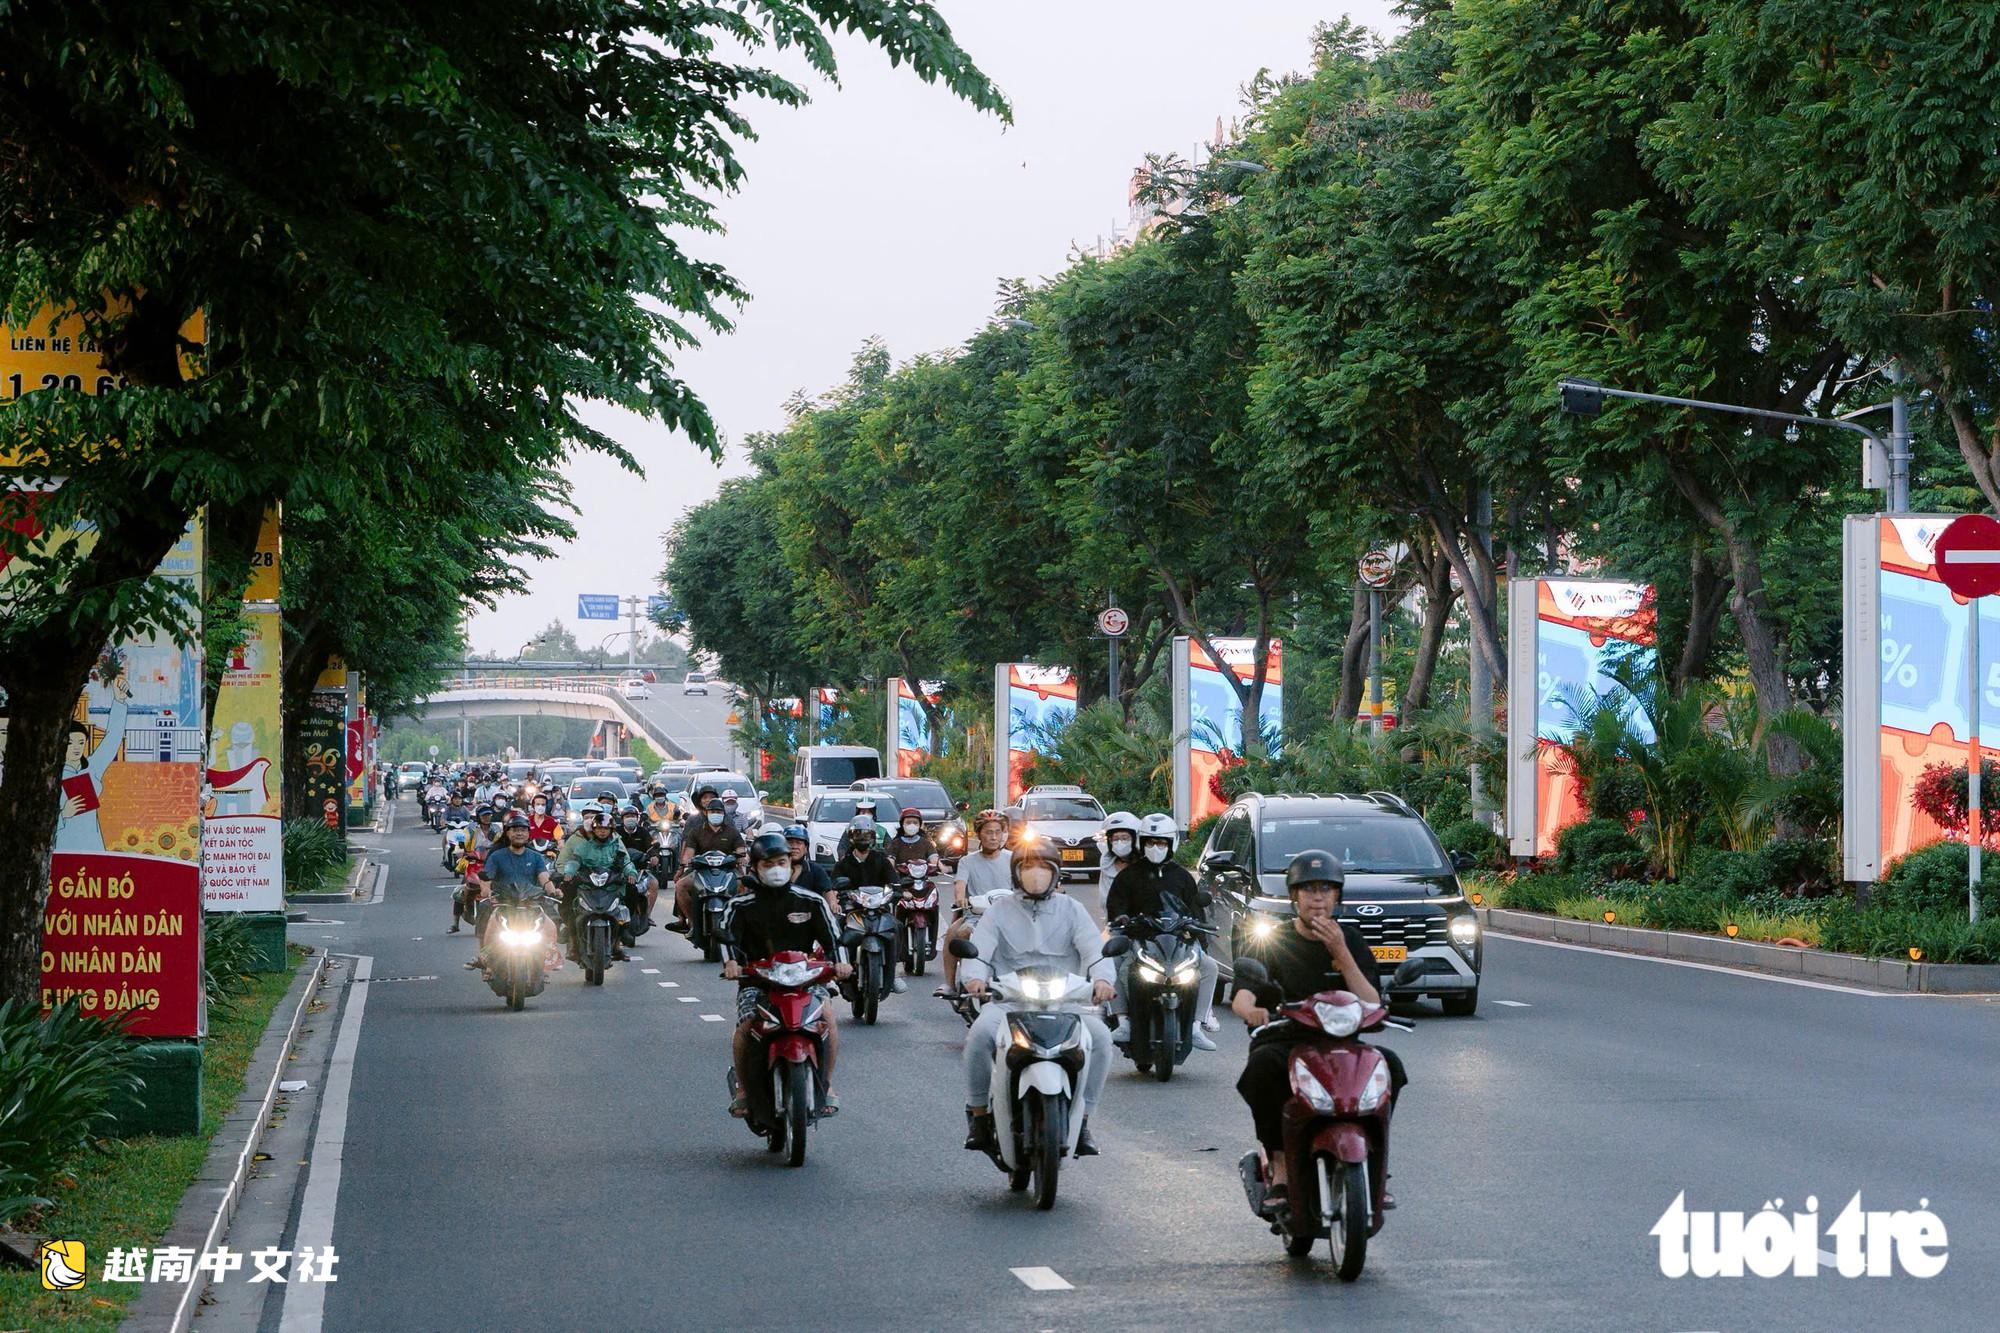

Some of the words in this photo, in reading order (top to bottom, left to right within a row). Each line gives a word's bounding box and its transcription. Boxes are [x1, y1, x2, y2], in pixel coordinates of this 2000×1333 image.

[11, 336, 45, 351] LIÊN
[52, 336, 71, 354] HỆ
[253, 551, 274, 567] 28
[213, 825, 224, 834] VÀ
[226, 824, 241, 834] SỨC
[243, 826, 266, 836] MẠNH
[219, 838, 236, 847] DÂN
[59, 866, 101, 898] GẮN
[108, 870, 134, 899] BÓ
[209, 875, 233, 887] QUỐC
[252, 878, 270, 886] NAM
[45, 907, 77, 936] VỚI
[83, 908, 138, 936] NHÂN
[143, 908, 183, 936] DÂN
[61, 945, 115, 973] NHÂN
[121, 945, 161, 973] DÂN
[104, 981, 160, 1011] ĐẢNG
